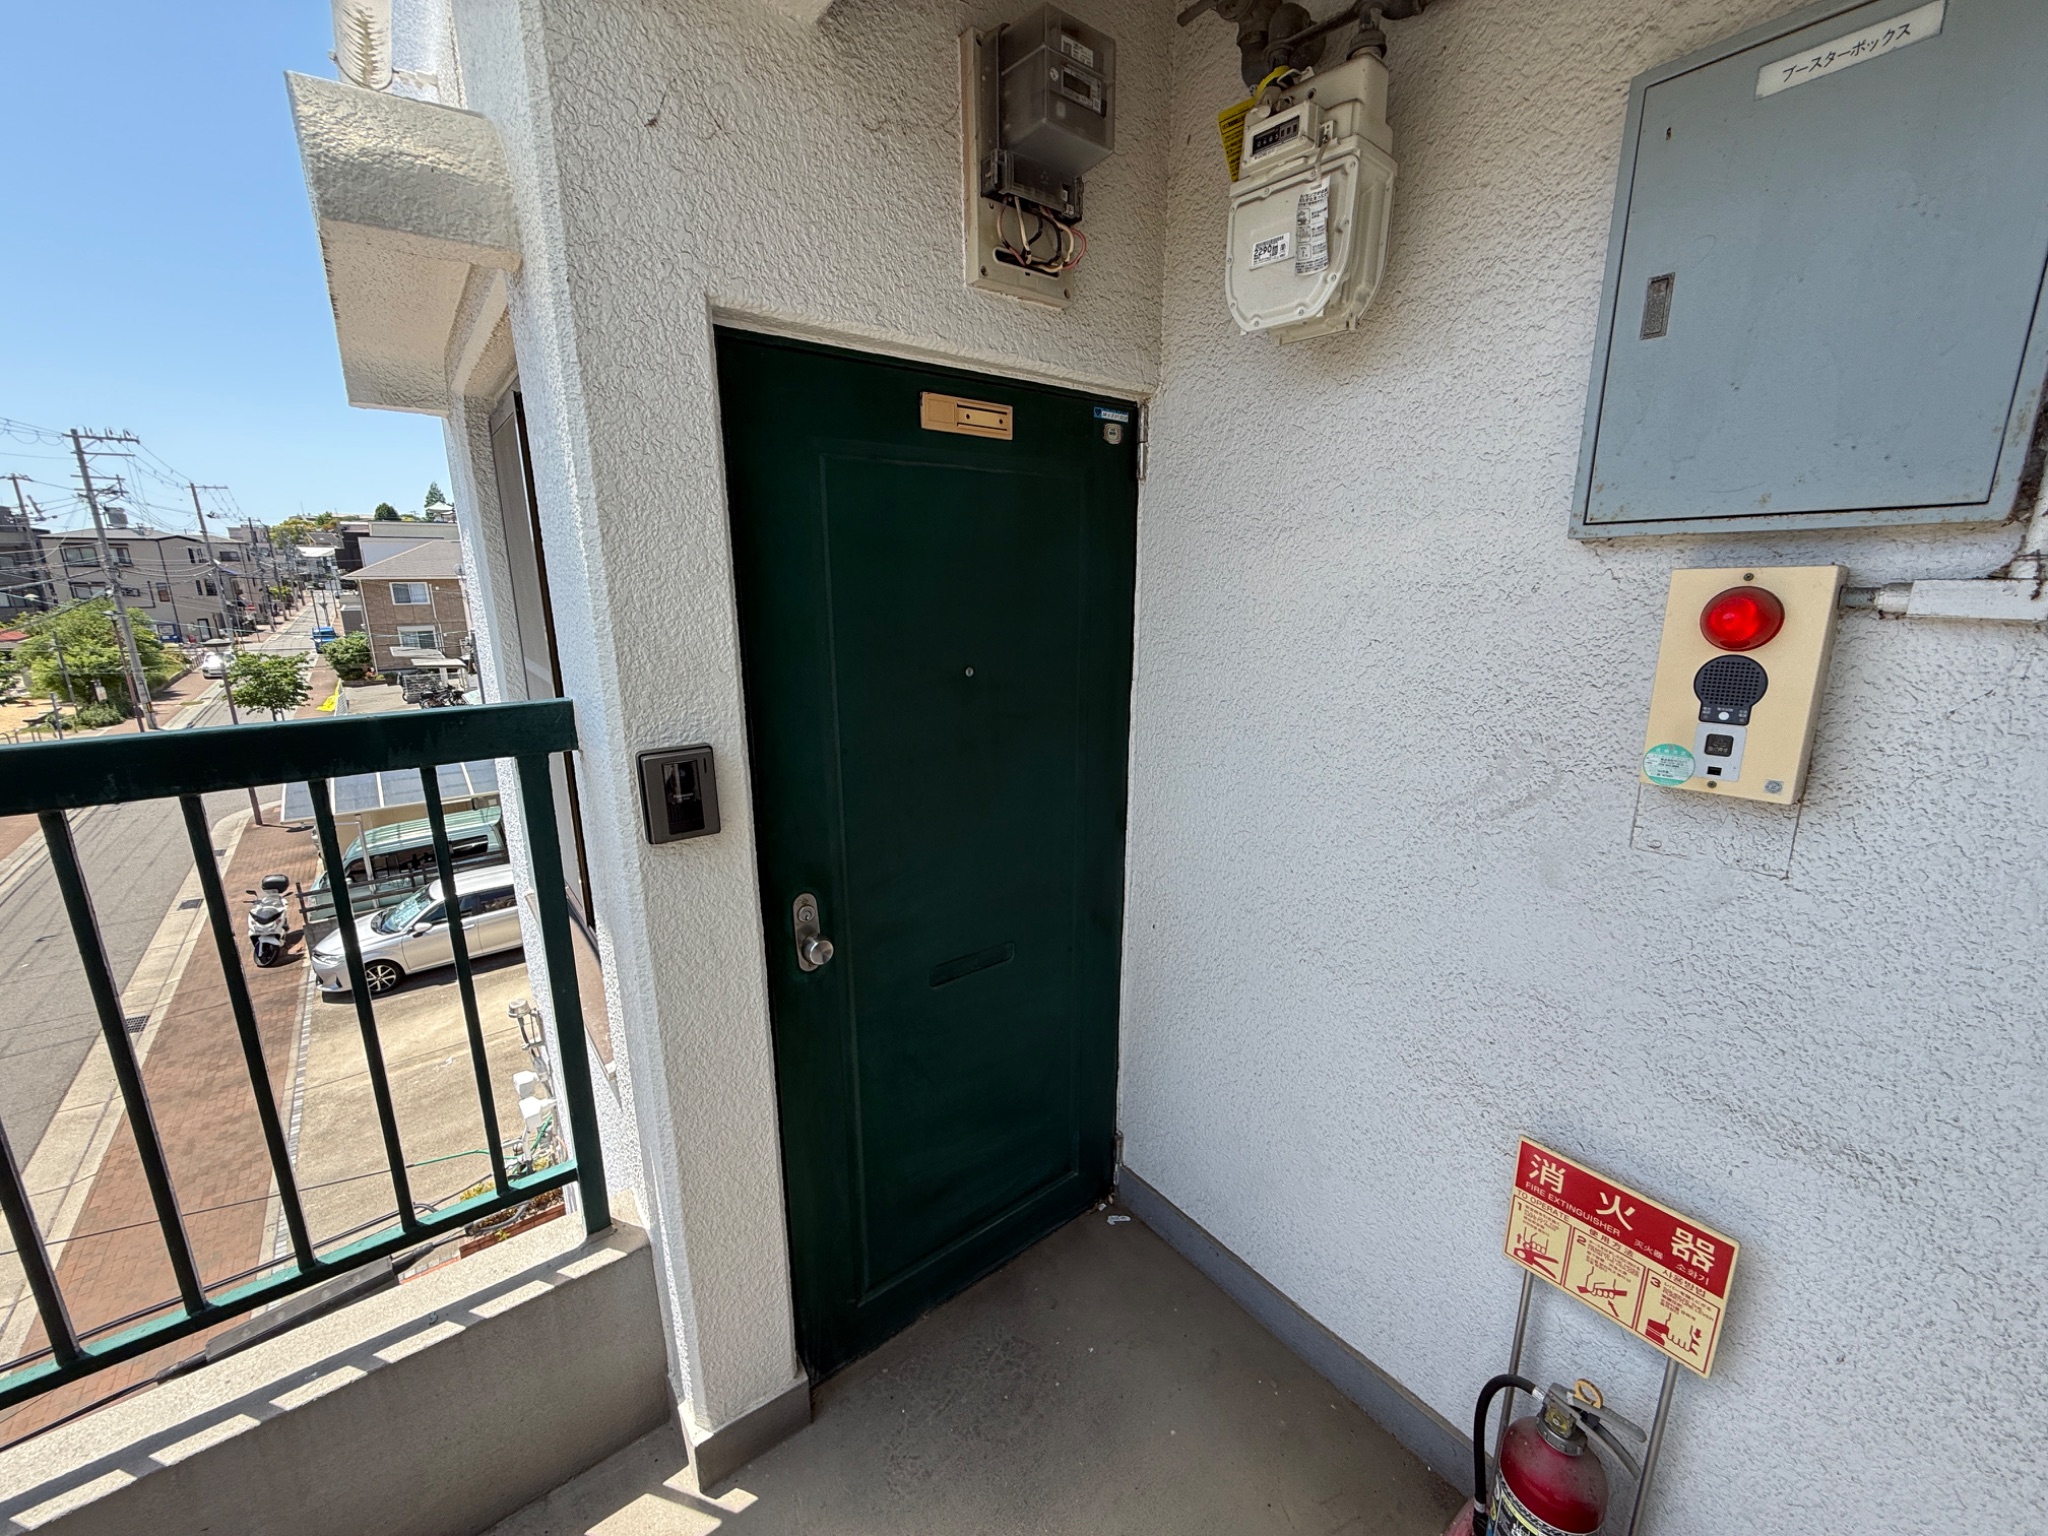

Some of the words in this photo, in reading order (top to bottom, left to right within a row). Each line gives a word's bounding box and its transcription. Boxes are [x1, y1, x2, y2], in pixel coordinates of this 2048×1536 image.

[1782, 23, 1911, 83] ブースターボックス
[1517, 1189, 1529, 1200] TO
[1530, 1196, 1570, 1222] OPERATE
[1517, 1202, 1523, 1211] 1
[1525, 1181, 1546, 1198] FIRE
[1548, 1193, 1621, 1237] EXTINGUISHER
[1529, 1154, 1716, 1273] 消火器
[1577, 1235, 1587, 1247] 2
[1589, 1228, 1634, 1258] 使用方法
[1650, 1276, 1661, 1289] 3
[1662, 1269, 1707, 1298] 사용방법
[1674, 1263, 1710, 1286] 소화기
